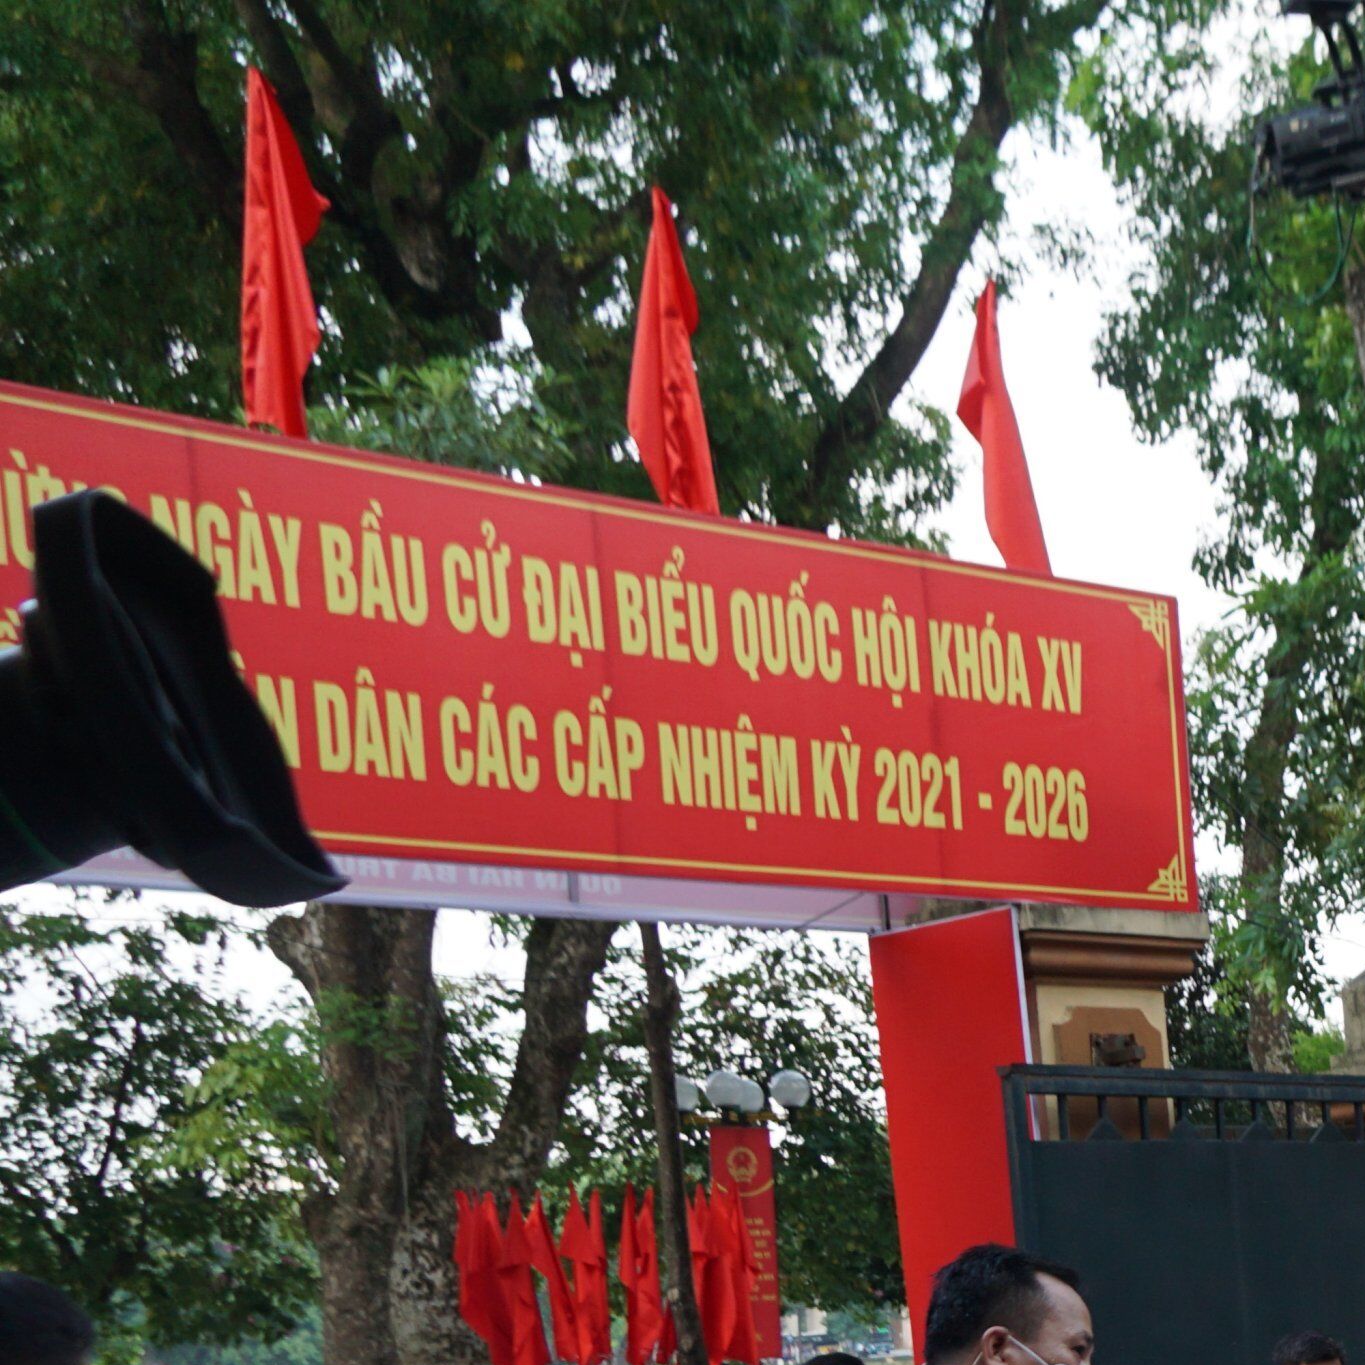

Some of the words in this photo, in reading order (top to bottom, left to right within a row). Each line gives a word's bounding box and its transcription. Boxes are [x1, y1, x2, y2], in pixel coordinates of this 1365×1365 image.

[318, 498, 429, 628] BẦU
[441, 518, 512, 640] CỬ
[521, 554, 606, 669] ĐẠI
[613, 545, 720, 668] BIỂU
[729, 569, 843, 683] QUỐC
[850, 594, 921, 709] HỘI
[927, 611, 1032, 709] KHÓA
[1036, 635, 1083, 715] XV
[312, 666, 428, 782] DÂN
[438, 682, 541, 796] CÁC
[552, 684, 646, 802] CẤP
[657, 713, 802, 832] NHIỆM
[809, 724, 862, 823] KỲ
[873, 745, 964, 831] 2021
[1001, 760, 1090, 843] 2026
